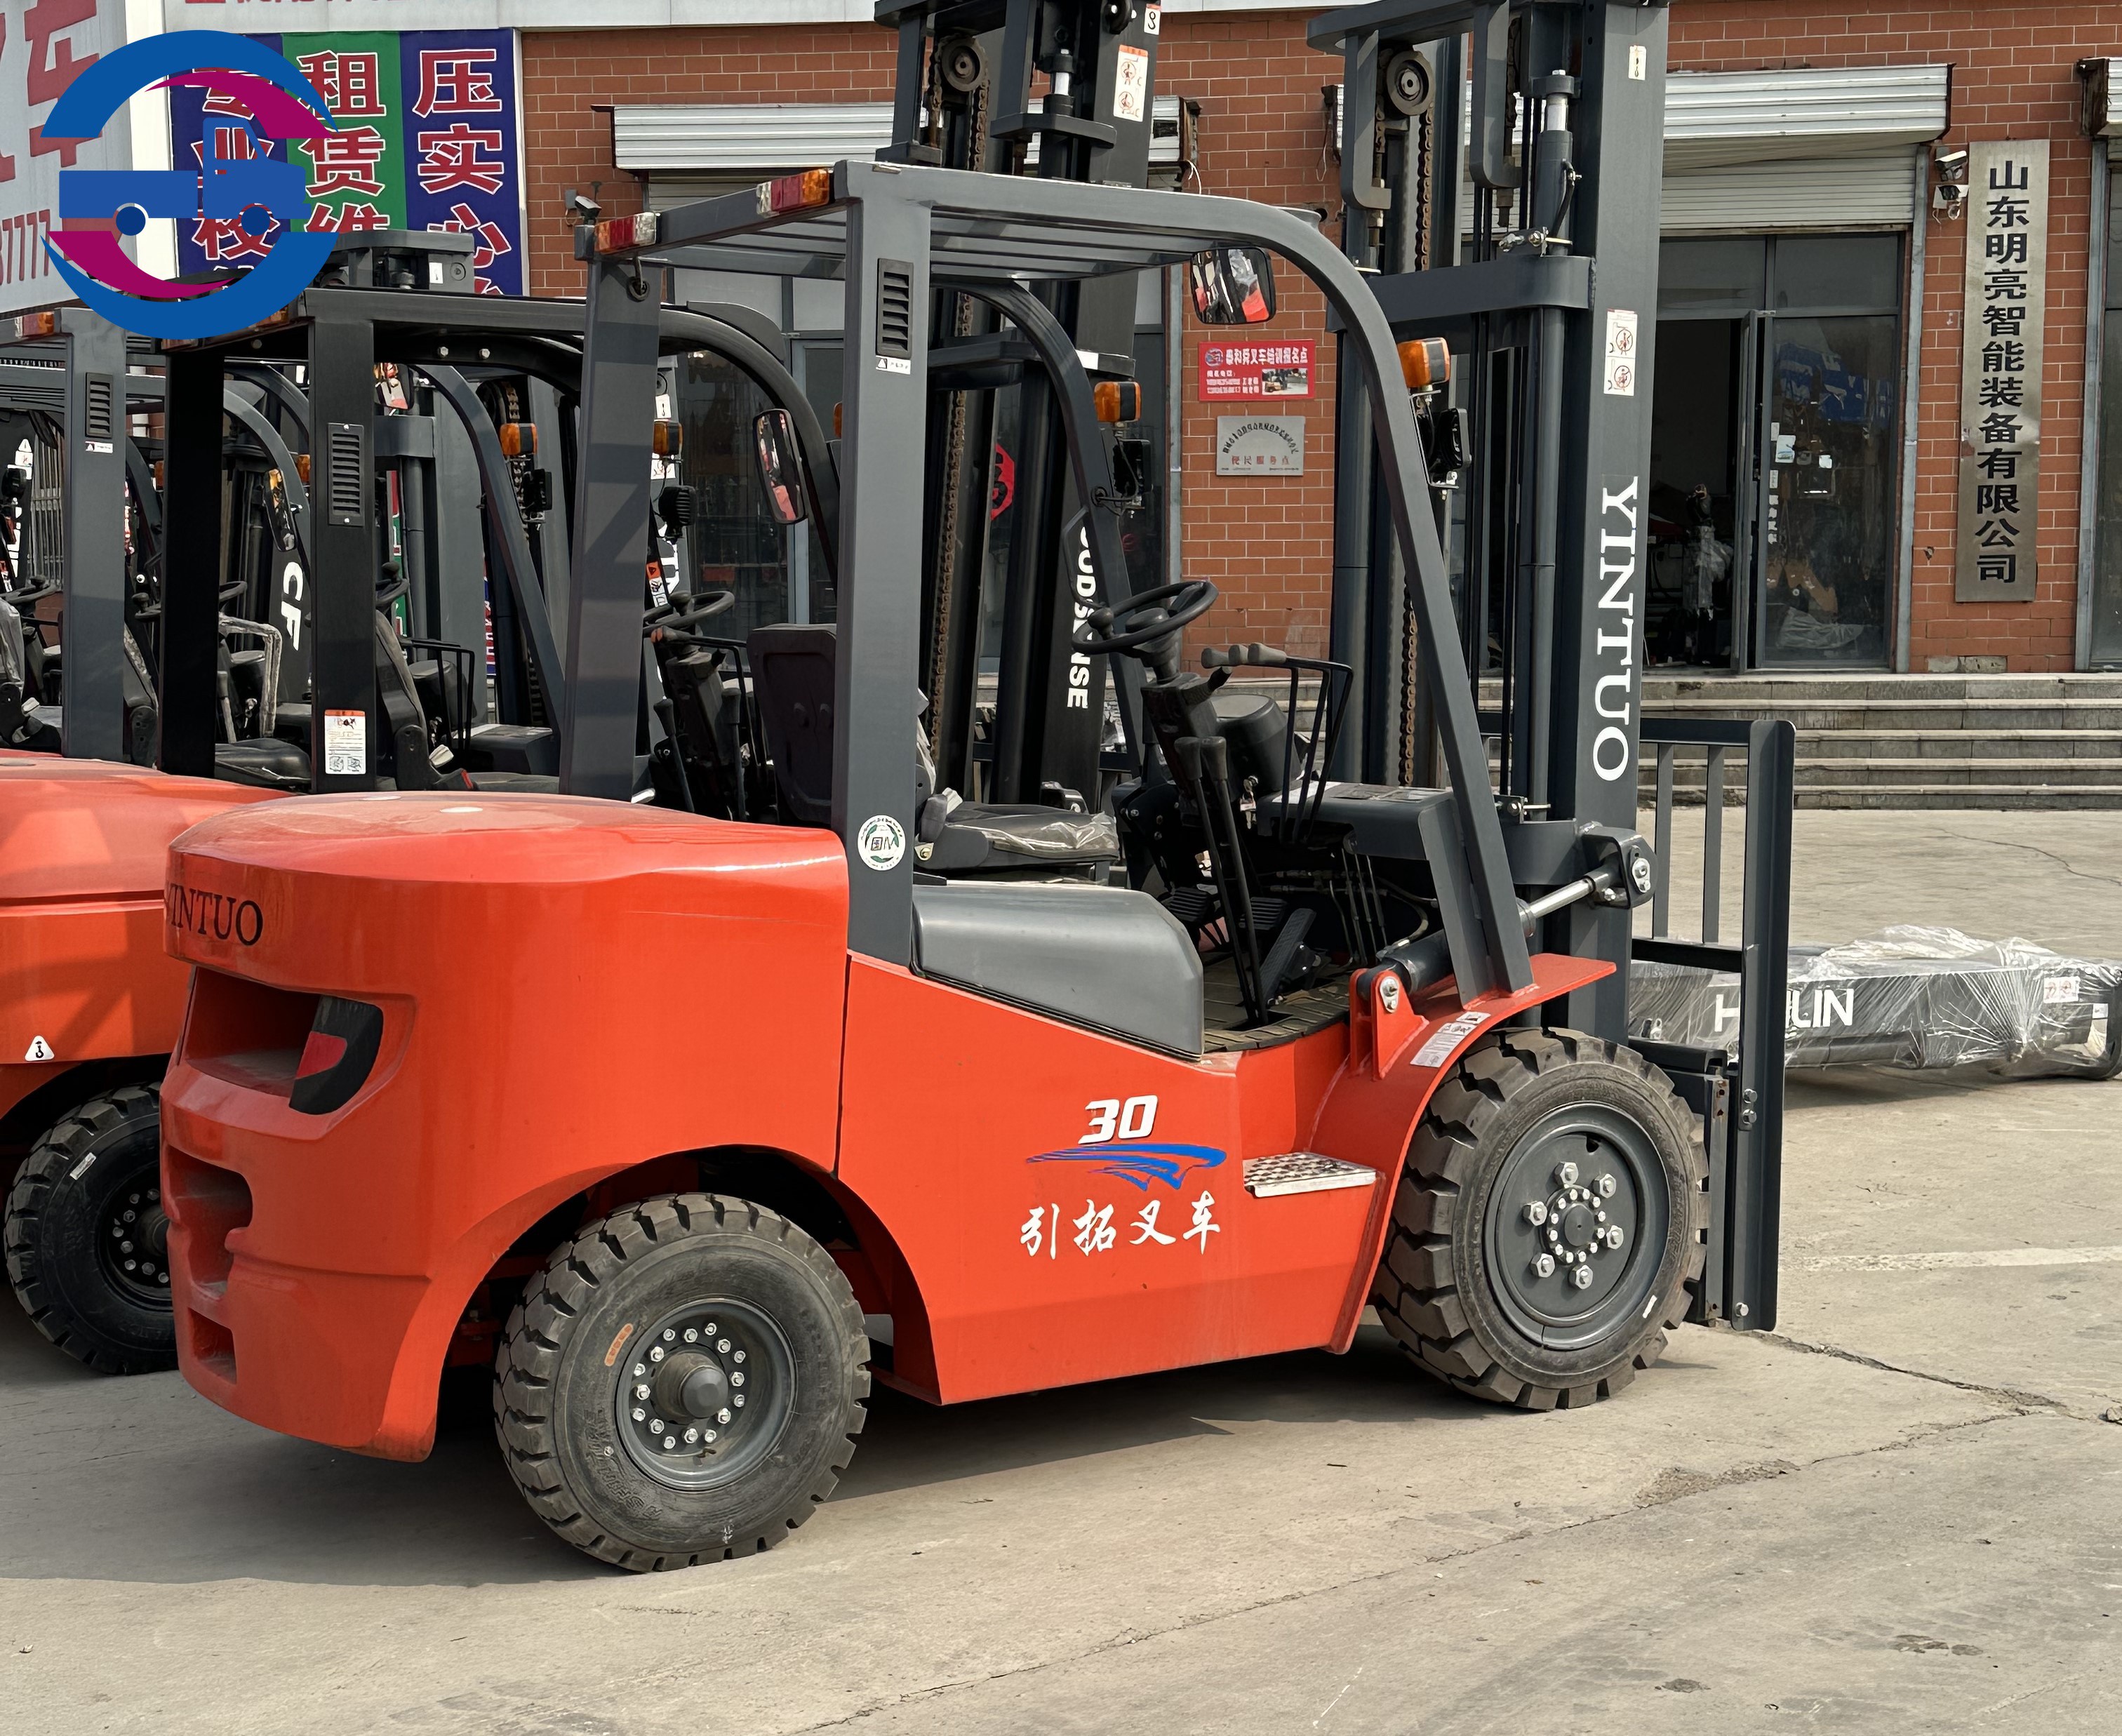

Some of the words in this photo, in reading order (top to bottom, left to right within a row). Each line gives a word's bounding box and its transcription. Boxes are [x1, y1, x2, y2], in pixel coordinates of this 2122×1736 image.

[413, 48, 512, 295] 压实心
[1975, 160, 2030, 584] 山东明亮智能装备有限公司
[1593, 476, 1639, 781] YINTUO
[166, 882, 263, 945] INTUO
[1079, 1095, 1158, 1144] 30
[1020, 1190, 1220, 1260] 引拓叉车
